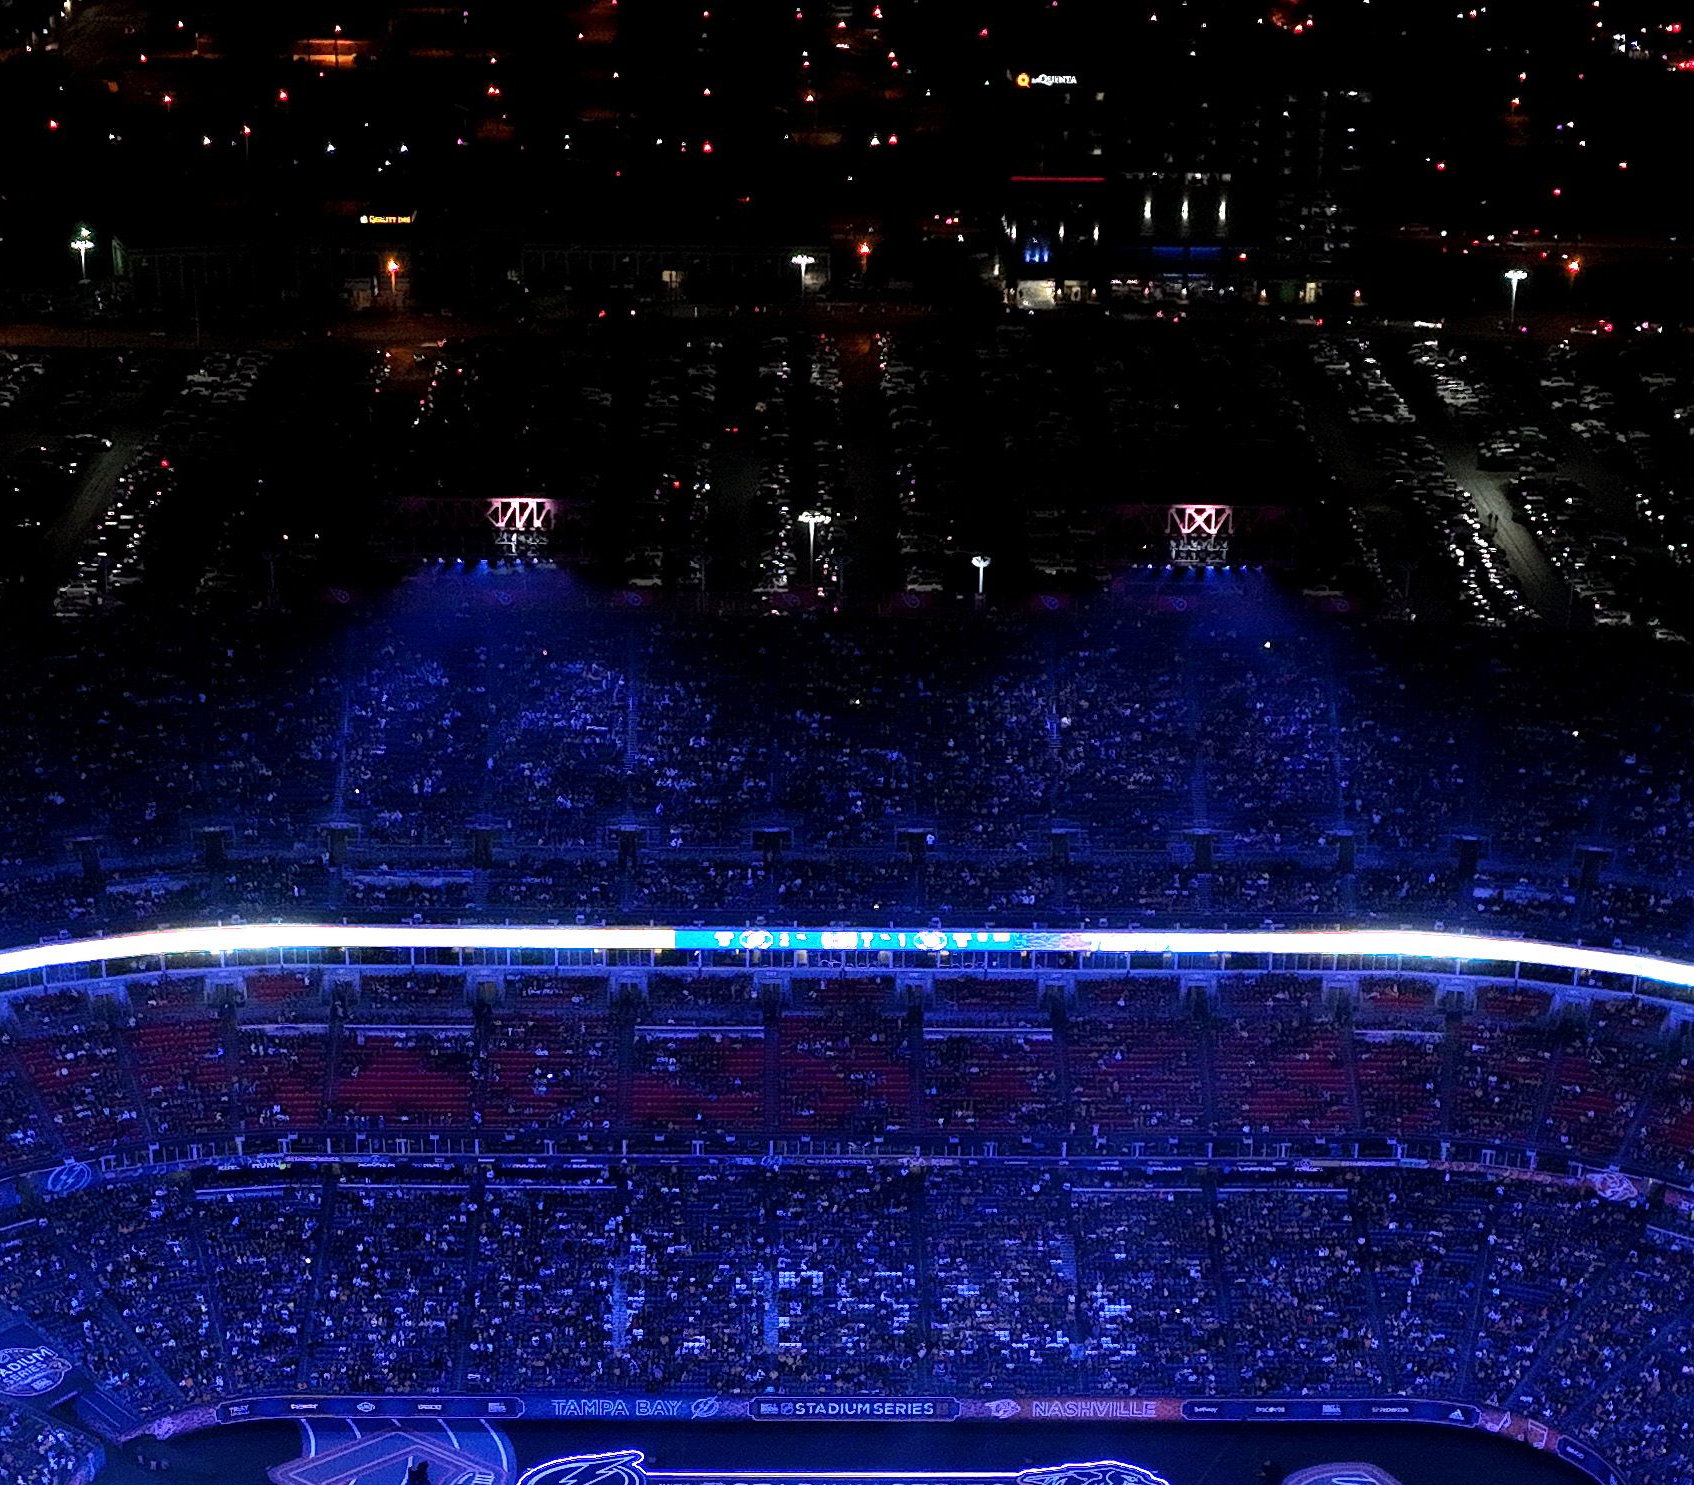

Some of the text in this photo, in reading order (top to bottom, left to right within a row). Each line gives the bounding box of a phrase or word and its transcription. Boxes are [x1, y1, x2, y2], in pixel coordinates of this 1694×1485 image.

[2, 1361, 47, 1386] SERIES
[551, 1399, 682, 1416] TAMPA BAY
[795, 1403, 870, 1415] STADIUM
[873, 1403, 934, 1415] SERIES
[1032, 1401, 1157, 1418] NASHVILLE
